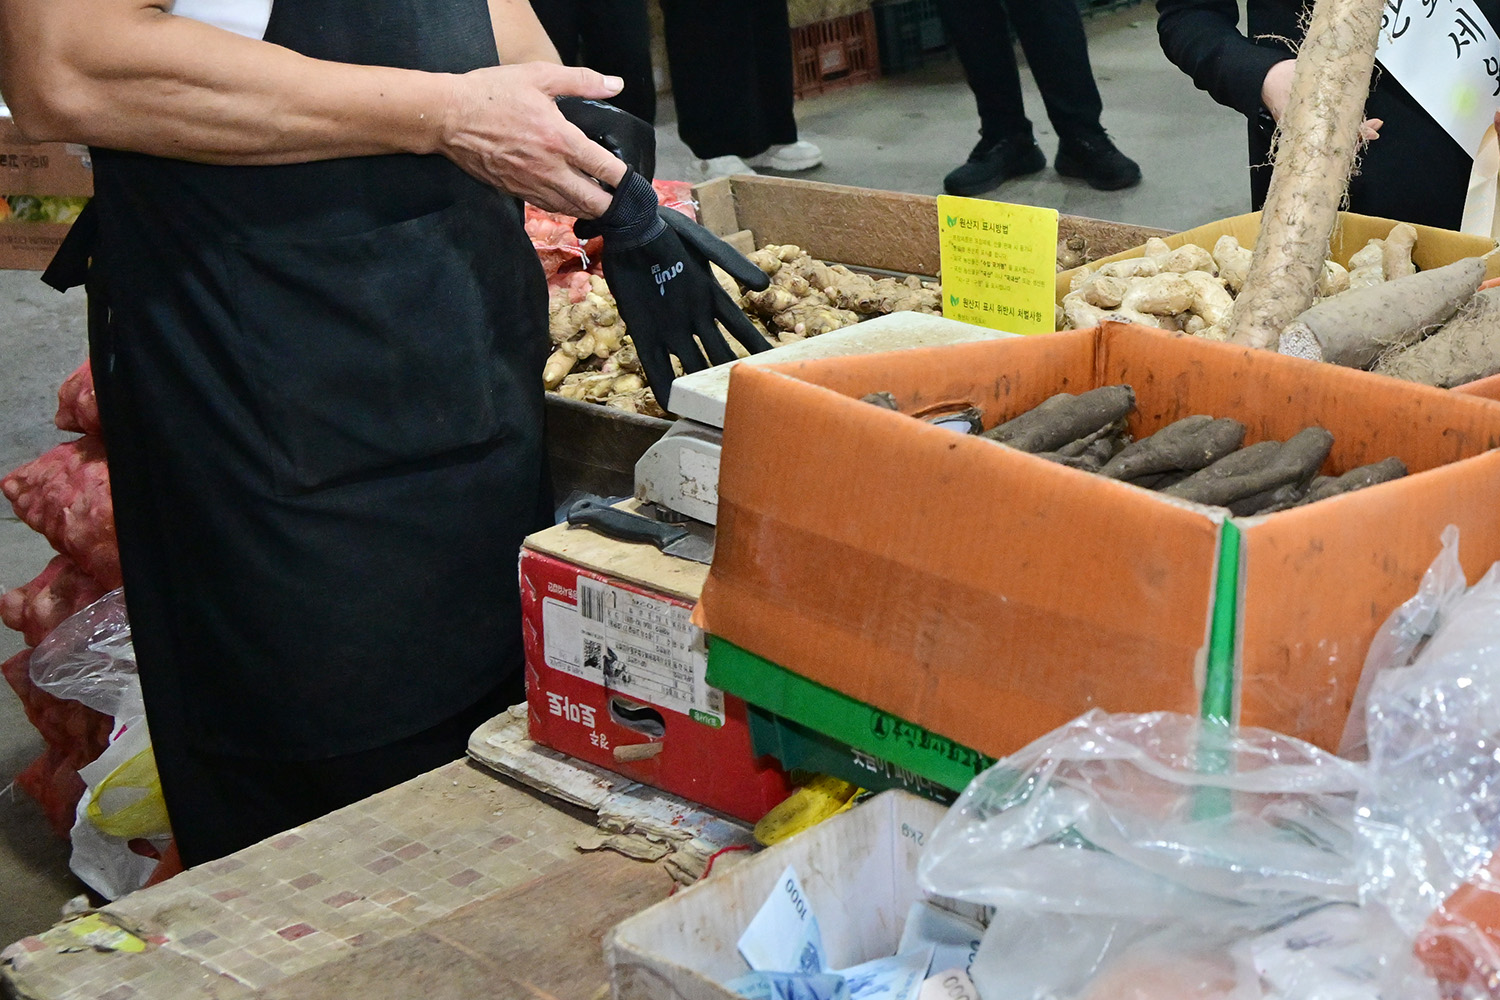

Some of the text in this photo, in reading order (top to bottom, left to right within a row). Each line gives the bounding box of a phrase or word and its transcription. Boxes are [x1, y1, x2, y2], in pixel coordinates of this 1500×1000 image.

[959, 217, 1009, 235] 원산지 표시방법
[962, 297, 1042, 323] 원산지 표시 위반시 처벌사항
[546, 690, 597, 729] 토마토
[589, 730, 610, 751] 경주
[784, 878, 808, 922] 1000
